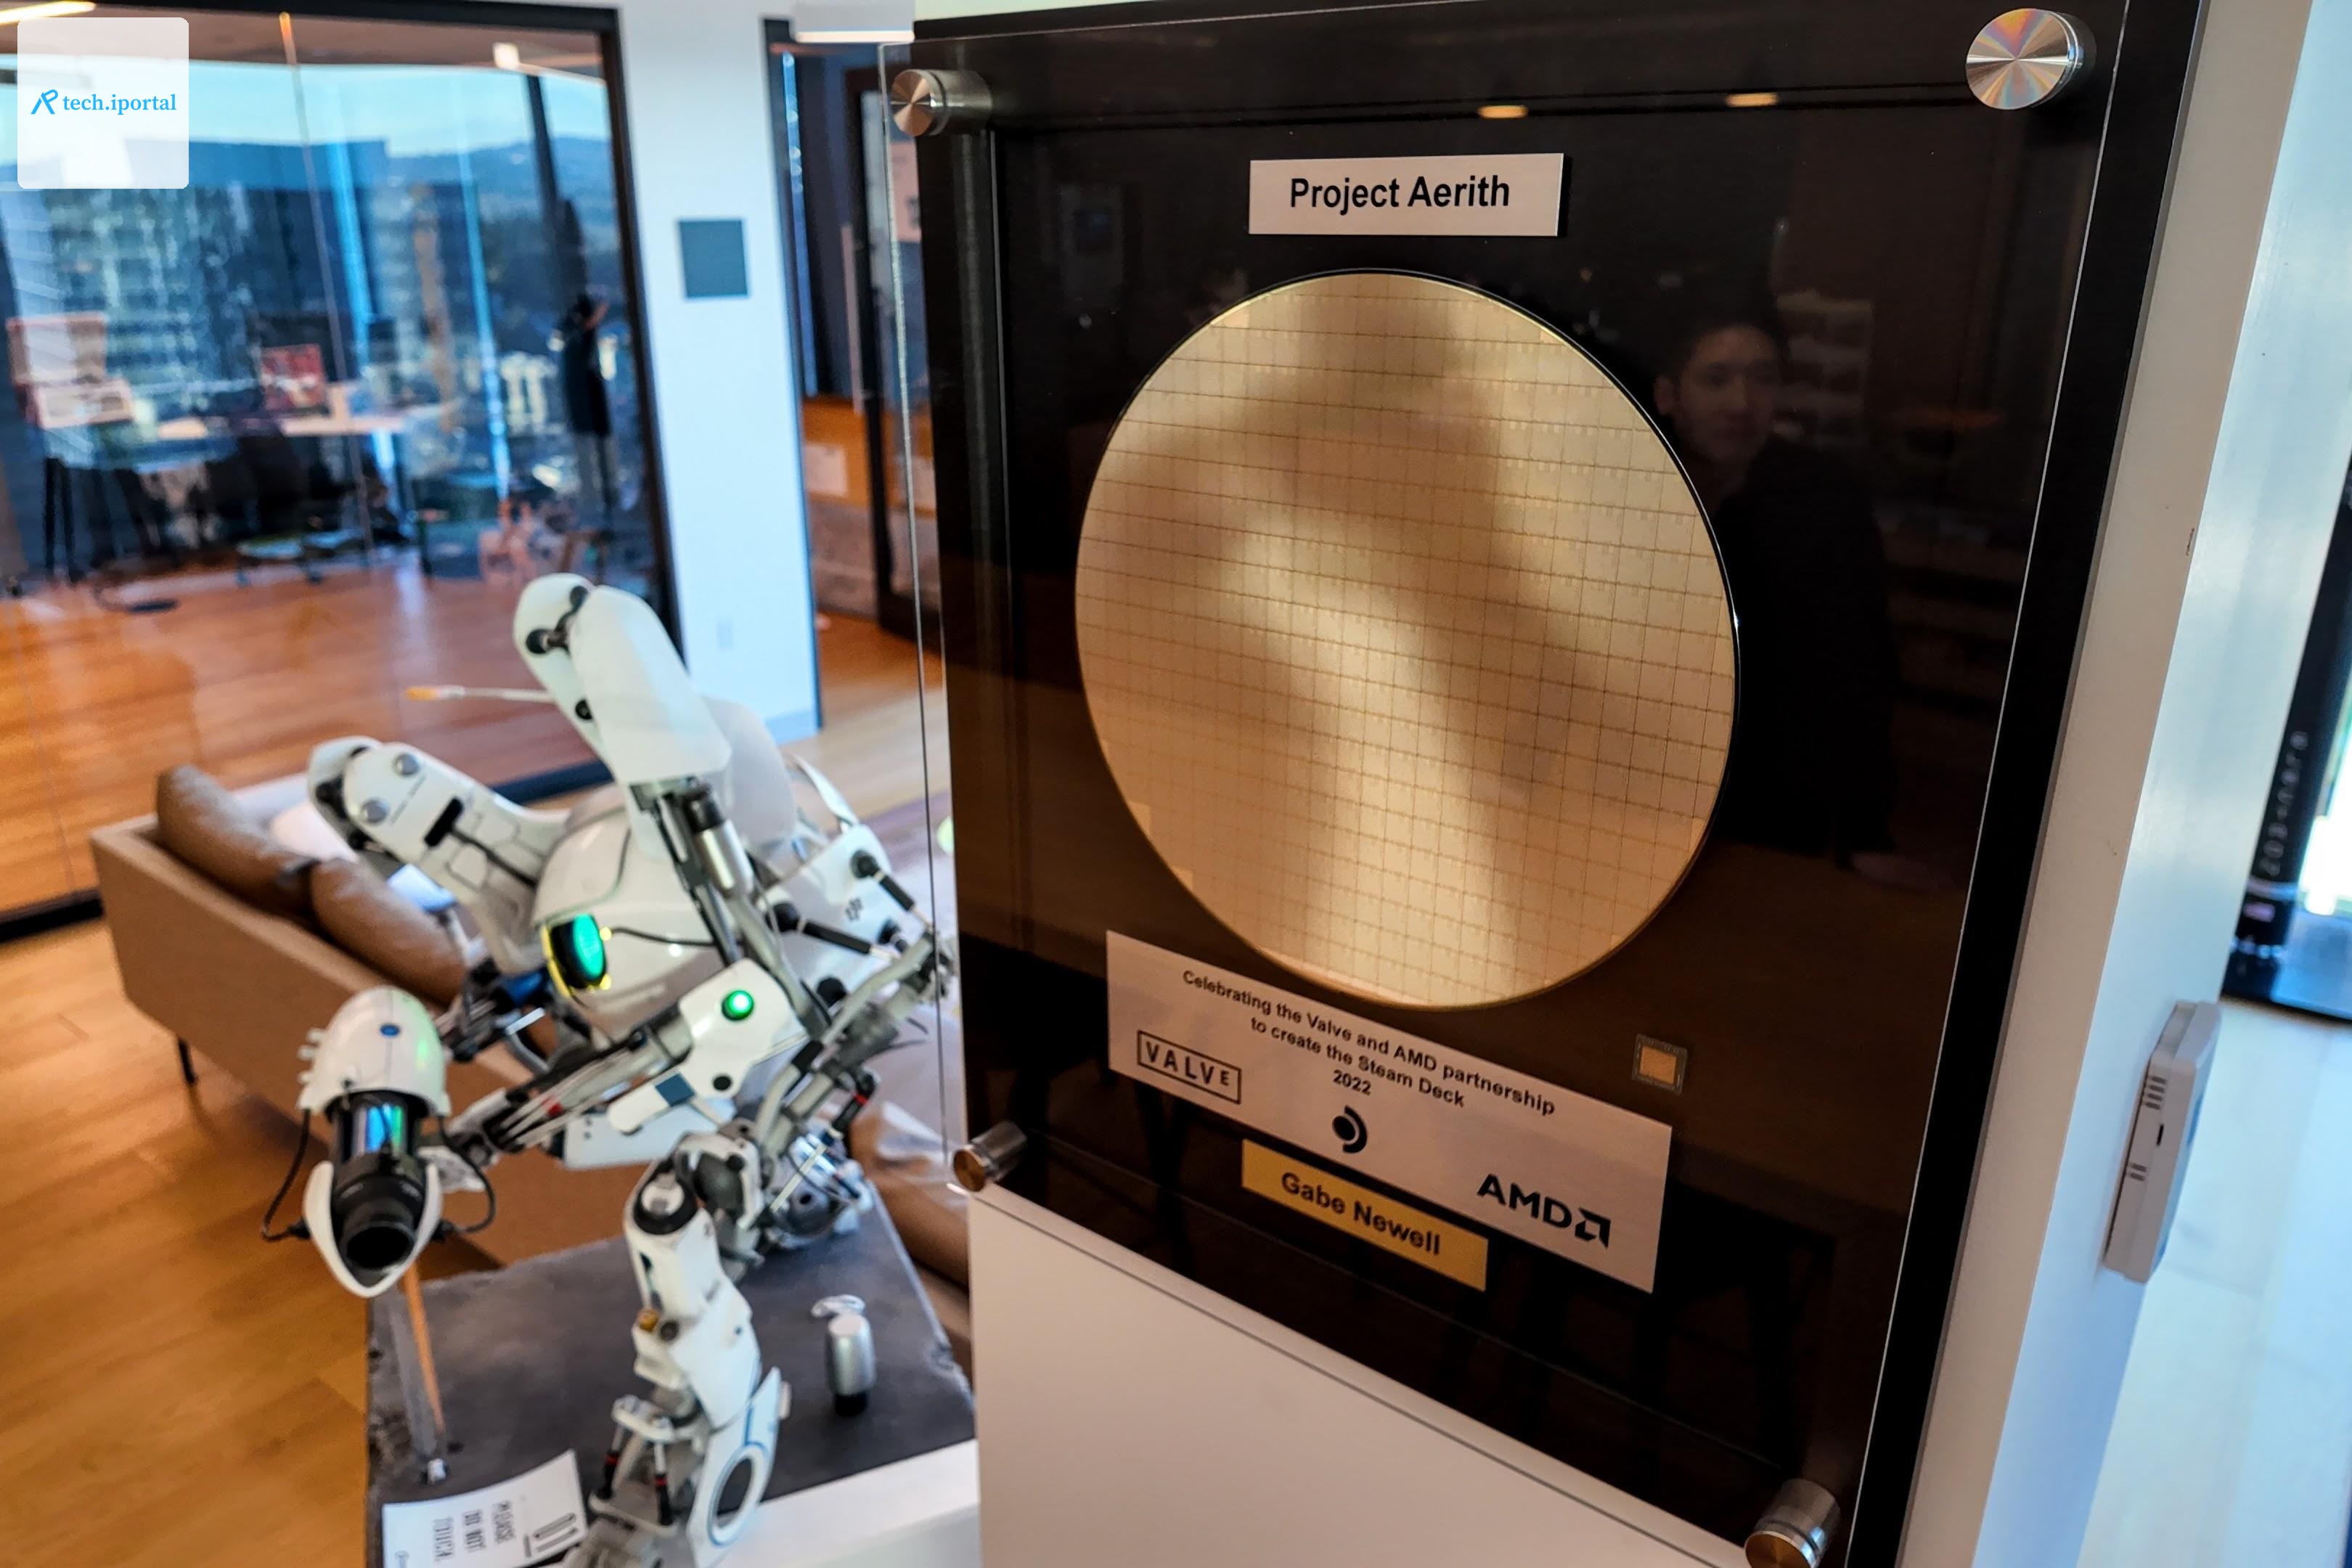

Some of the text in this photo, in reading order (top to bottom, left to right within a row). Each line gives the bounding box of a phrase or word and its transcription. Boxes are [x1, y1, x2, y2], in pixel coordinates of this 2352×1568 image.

[1291, 175, 1510, 216] Project Aerith
[1146, 1040, 1229, 1087] VALVE
[1183, 970, 1555, 1116] Celebrating the Valve and AMD partnership
[1251, 1016, 1465, 1108] to create the Steam Deck
[1333, 1069, 1371, 1095] 2022
[1281, 1172, 1440, 1255] Gabe Newell
[1477, 1173, 1572, 1228] AMD
